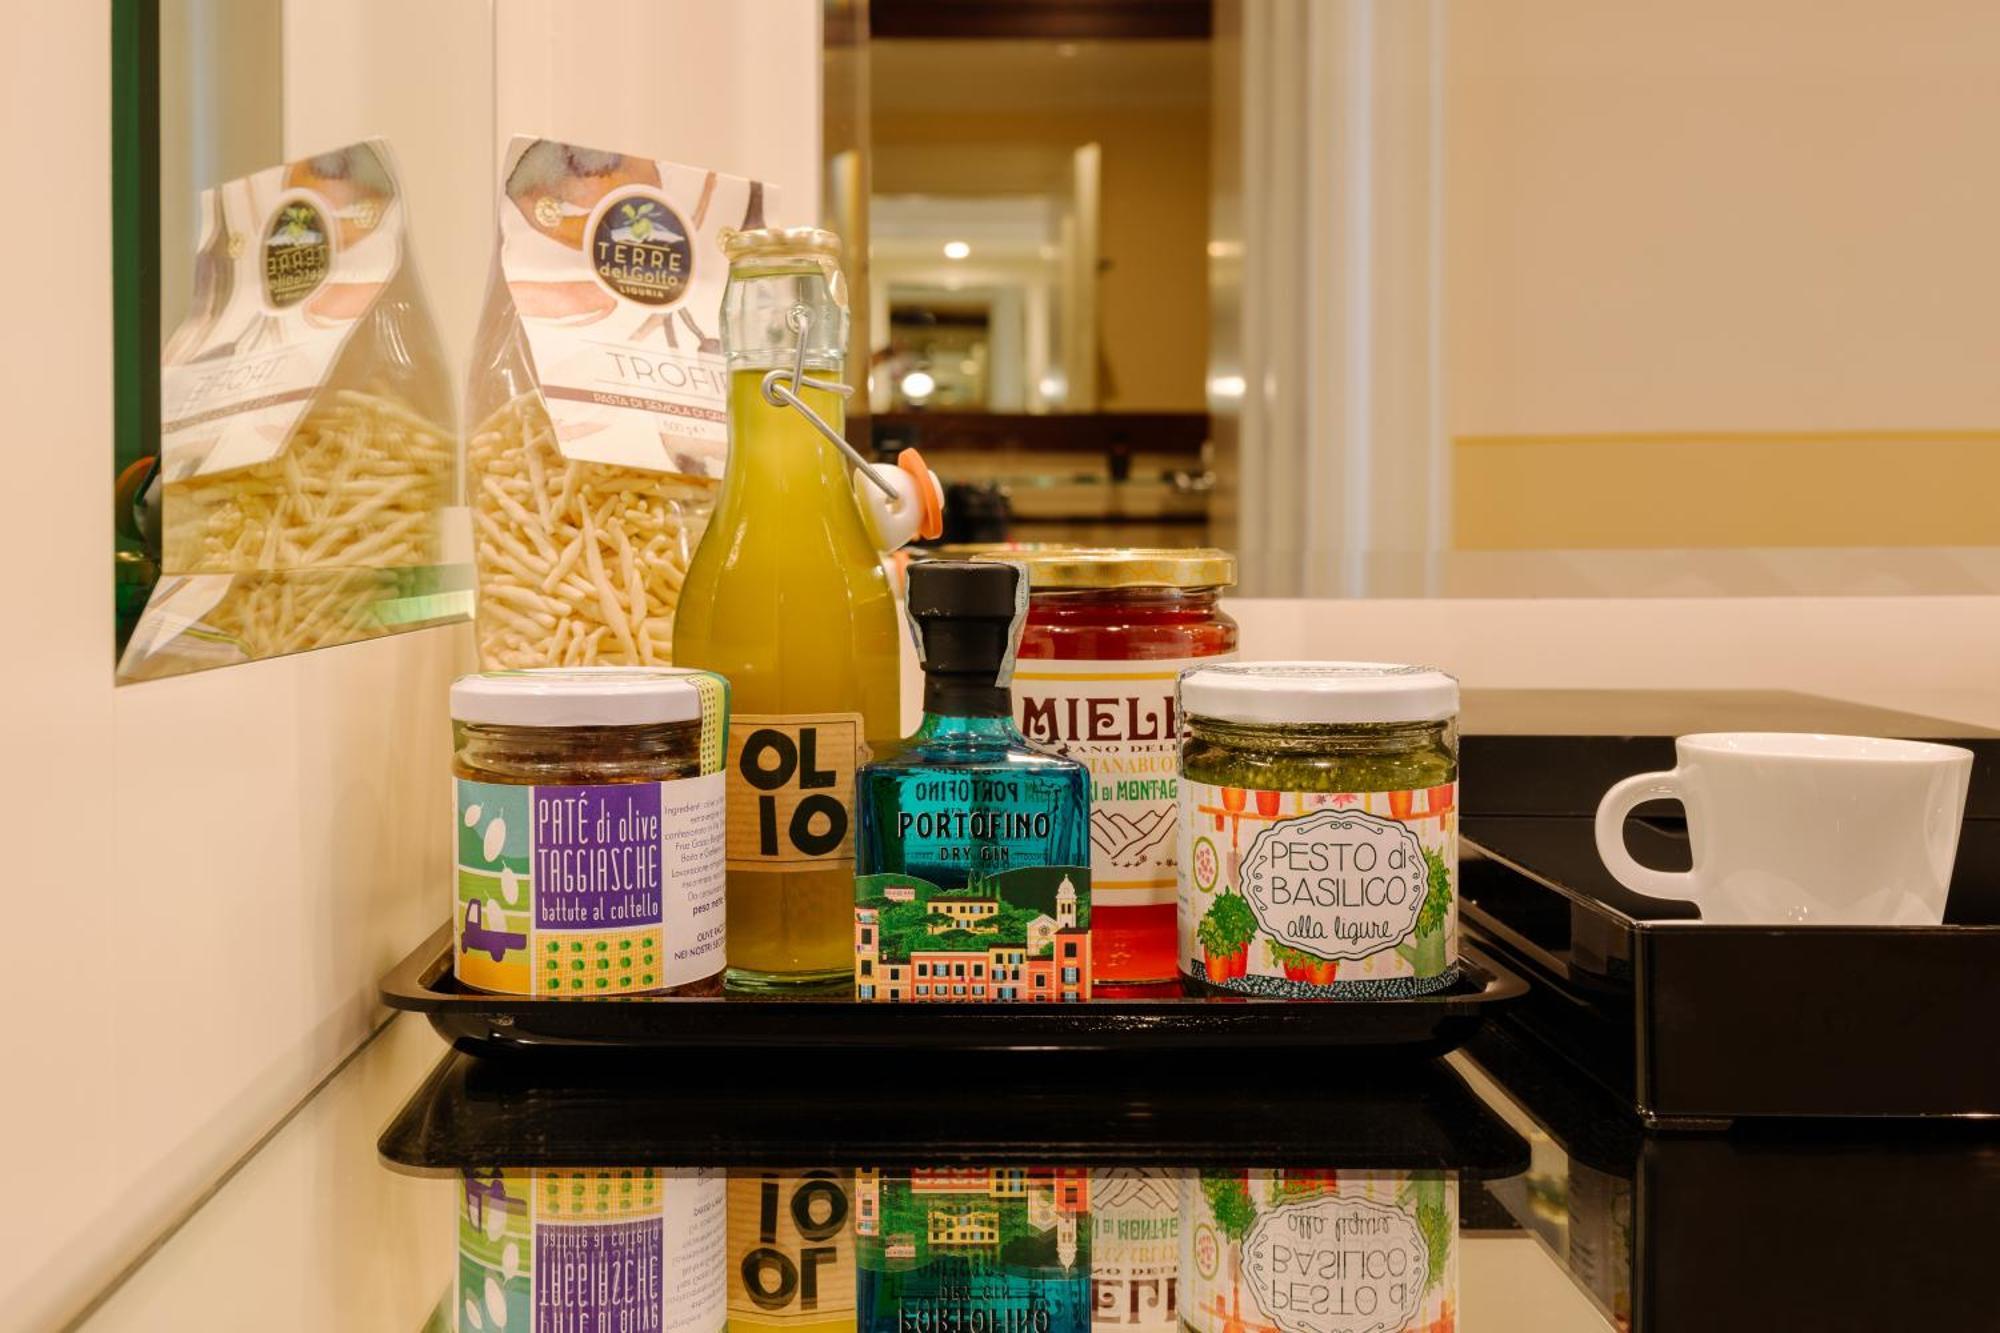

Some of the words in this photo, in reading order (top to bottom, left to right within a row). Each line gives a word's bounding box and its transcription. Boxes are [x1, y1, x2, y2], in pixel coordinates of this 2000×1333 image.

[598, 241, 682, 272] TERRE
[620, 285, 664, 298] LIGURIA
[592, 391, 628, 406] PASTA
[630, 397, 643, 409] DI
[1067, 745, 1119, 753] ANO
[1102, 787, 1112, 801] DI
[539, 791, 588, 844] PATÉ
[597, 798, 610, 843] di
[620, 797, 657, 842] olive
[897, 811, 1050, 839] PORTOFINO
[940, 846, 971, 861] DRY
[980, 845, 1009, 861] GIN
[1271, 840, 1377, 872] PESTO
[1388, 841, 1406, 870] di
[538, 845, 658, 893] TAGGIASCHE
[1271, 875, 1407, 907] BASILICO
[542, 897, 588, 922] battute
[593, 897, 604, 921] al
[611, 892, 658, 920] coltello
[692, 903, 710, 917] peso
[697, 929, 713, 942] OLIVE
[1287, 915, 1328, 939] alla
[1334, 915, 1393, 945] ligure
[674, 950, 687, 960] NEI
